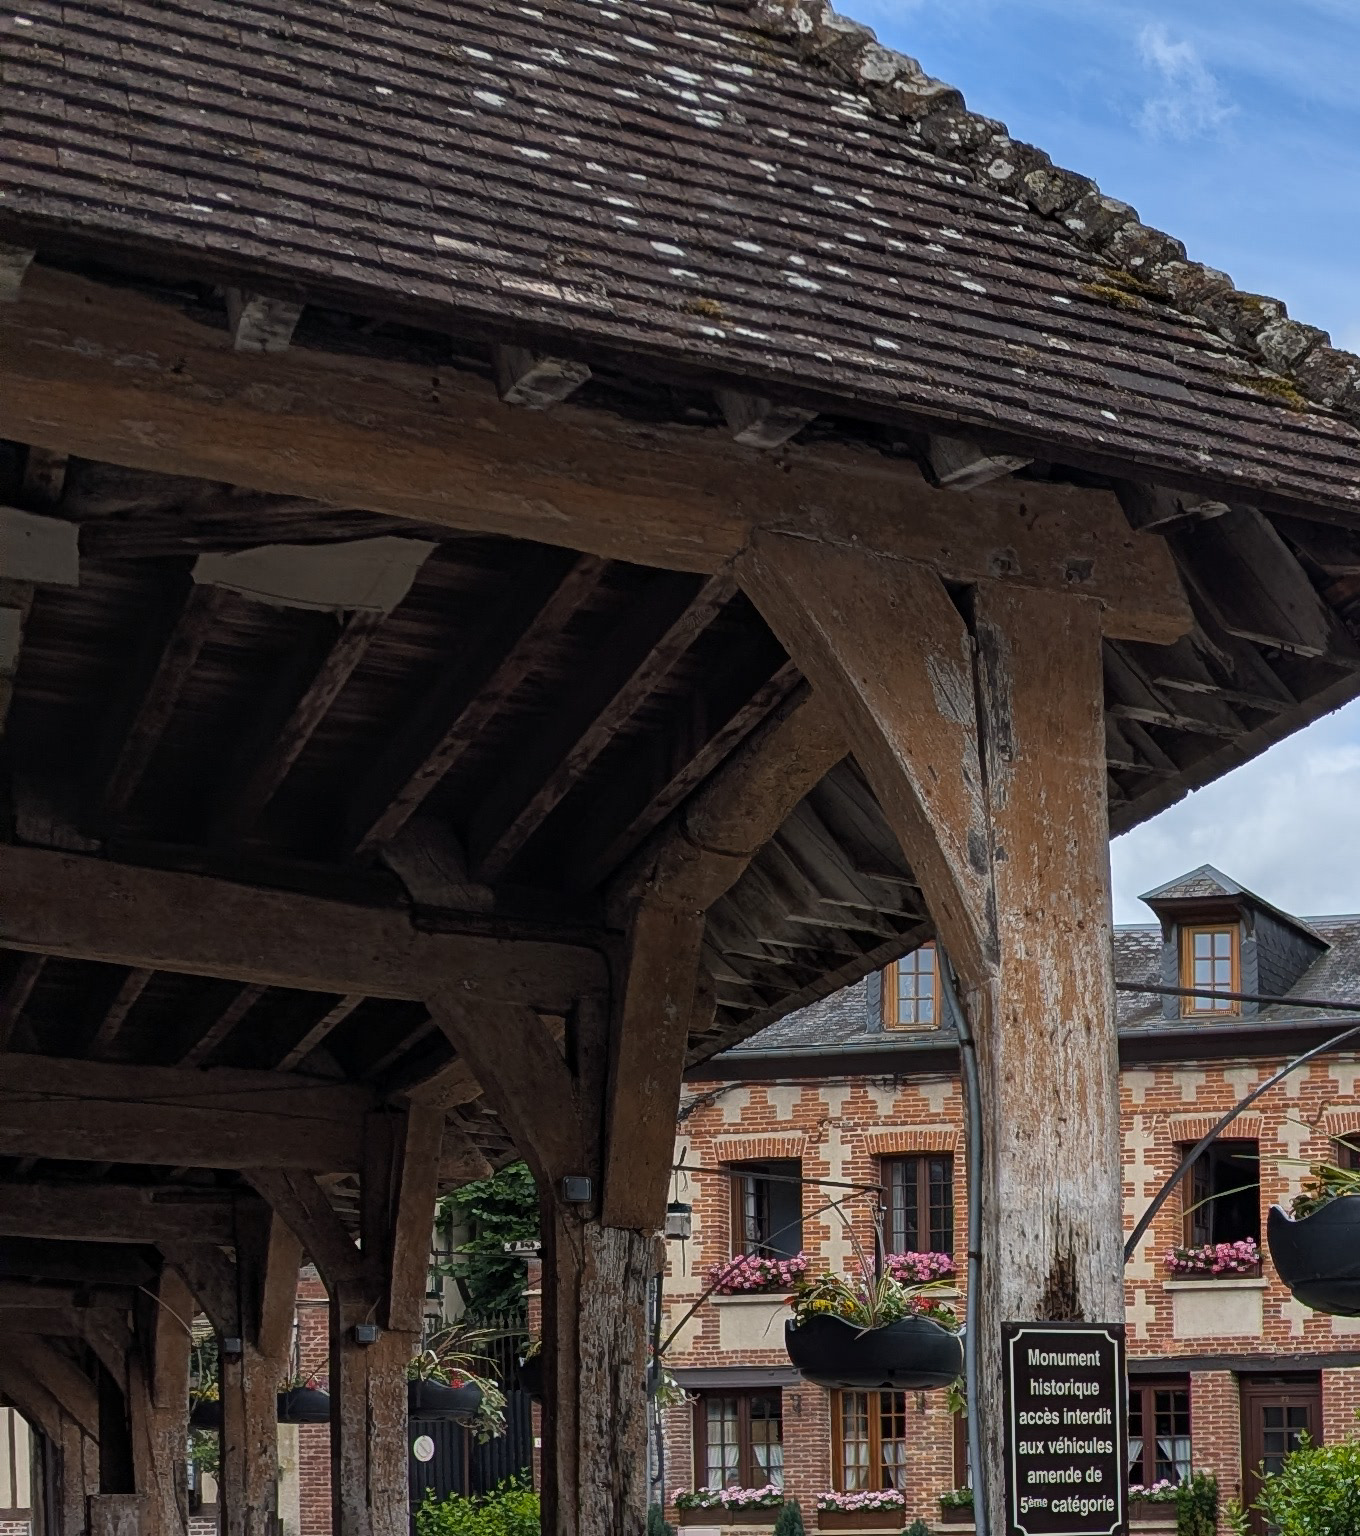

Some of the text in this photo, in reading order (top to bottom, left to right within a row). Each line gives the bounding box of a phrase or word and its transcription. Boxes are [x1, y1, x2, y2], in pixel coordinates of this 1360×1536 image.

[1027, 1348, 1101, 1367] Monument
[1029, 1378, 1100, 1400] historique
[1019, 1407, 1112, 1425] accès interdit
[1018, 1436, 1113, 1455] aux véhicules
[1027, 1466, 1103, 1484] amende de
[1020, 1495, 1115, 1516] 5ème catégorie
